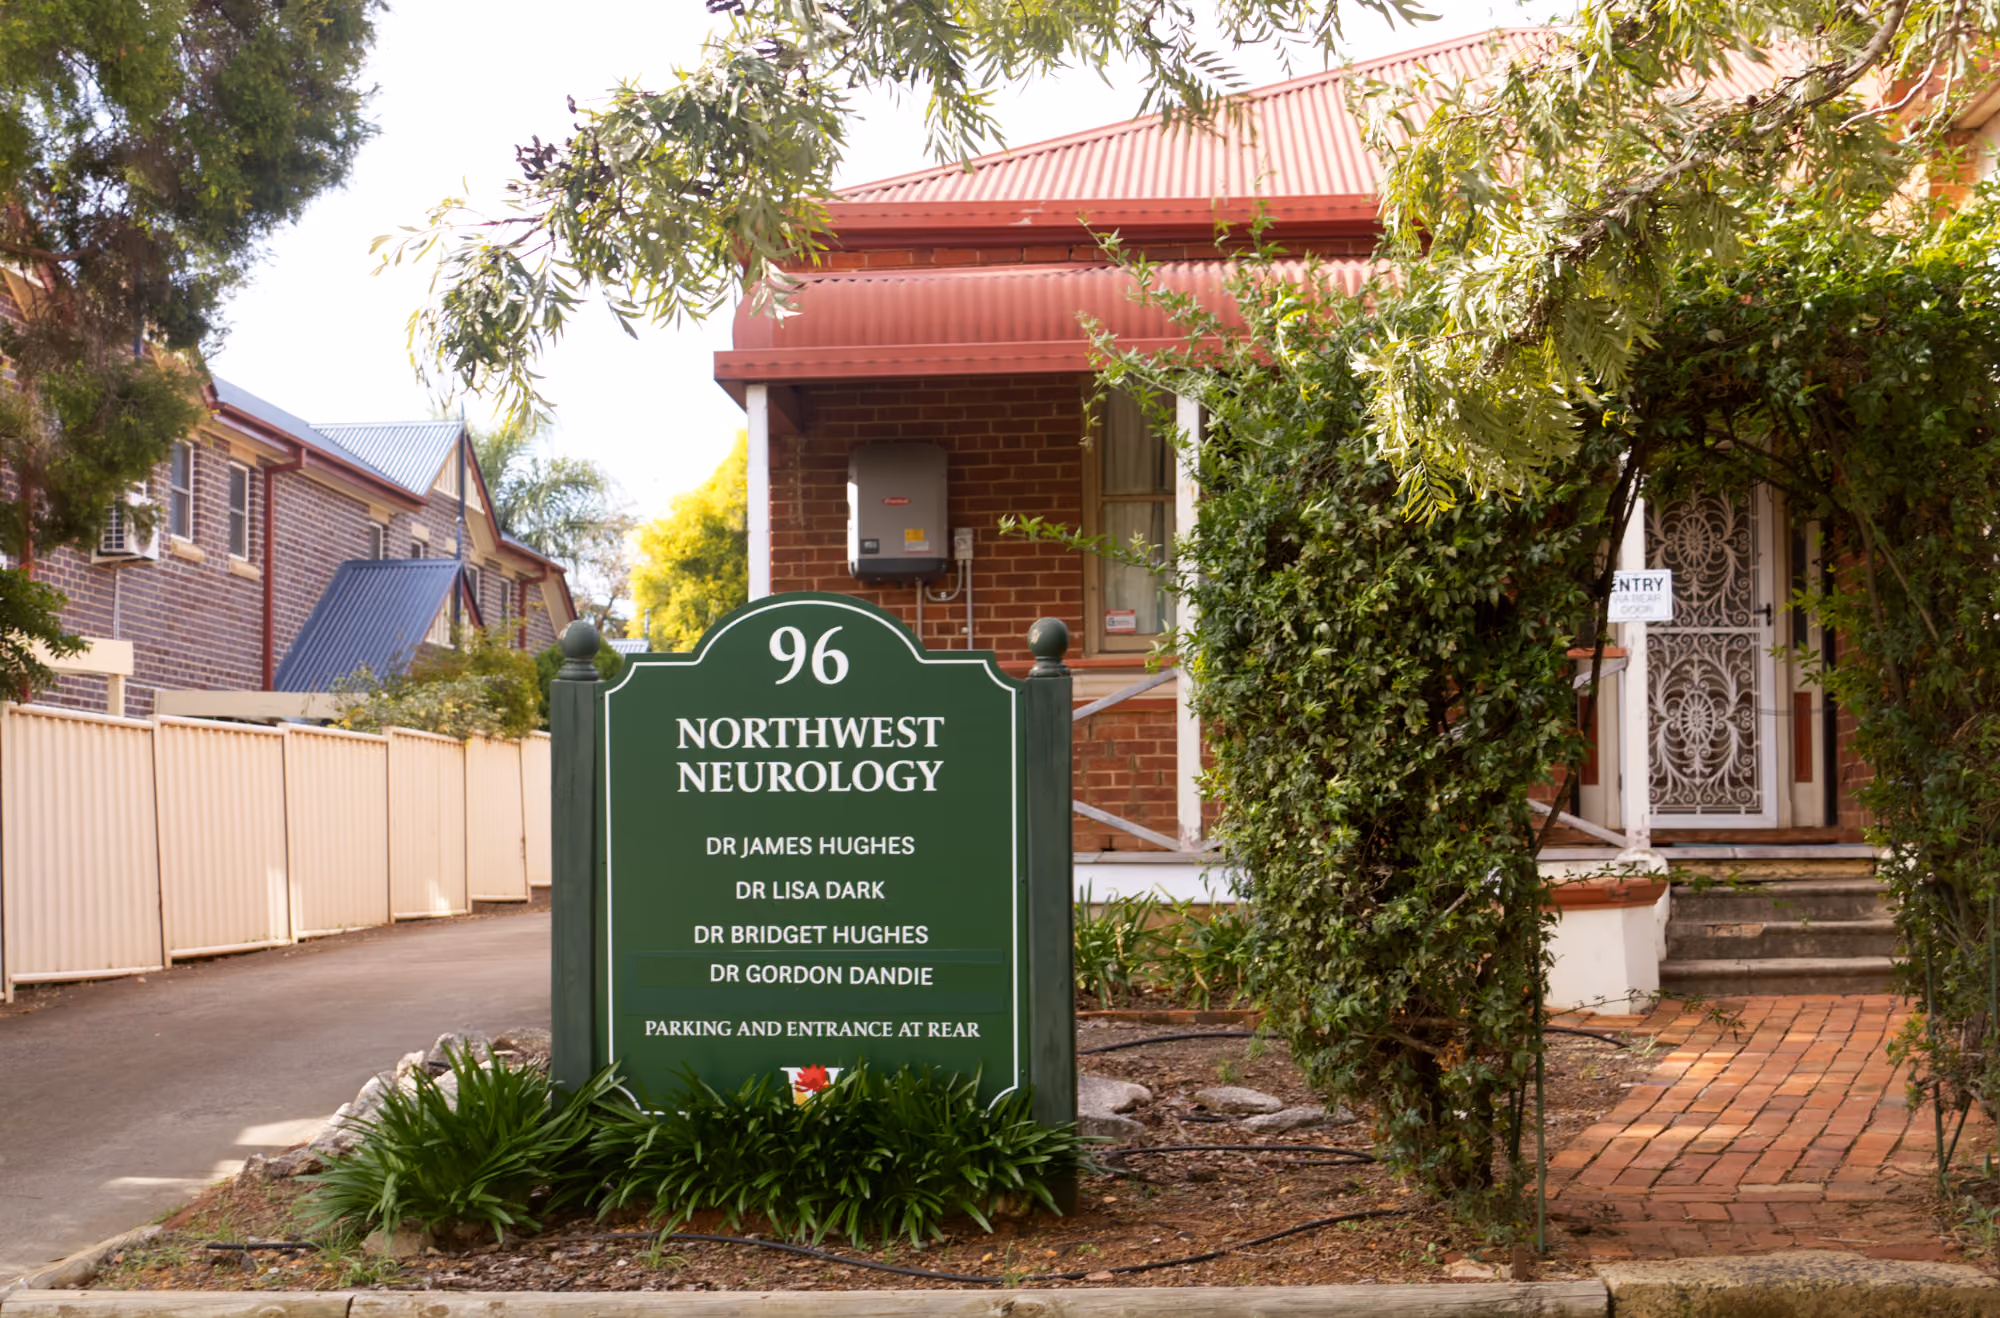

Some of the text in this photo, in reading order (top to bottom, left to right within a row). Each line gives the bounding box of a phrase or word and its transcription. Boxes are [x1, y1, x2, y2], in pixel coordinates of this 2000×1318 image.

[768, 625, 850, 687] 96
[675, 715, 945, 750] NORTHWEST
[675, 760, 945, 793] NEUROLOGY
[706, 835, 915, 859] DR JAMES HUGHES
[735, 880, 886, 900] DR LISA DARK
[693, 924, 929, 945] DR BRIDGET HUGHES
[710, 963, 934, 986] DR GORDON DANDIE
[645, 1020, 981, 1038] PARKING AND ENTRANCE AT REAR
